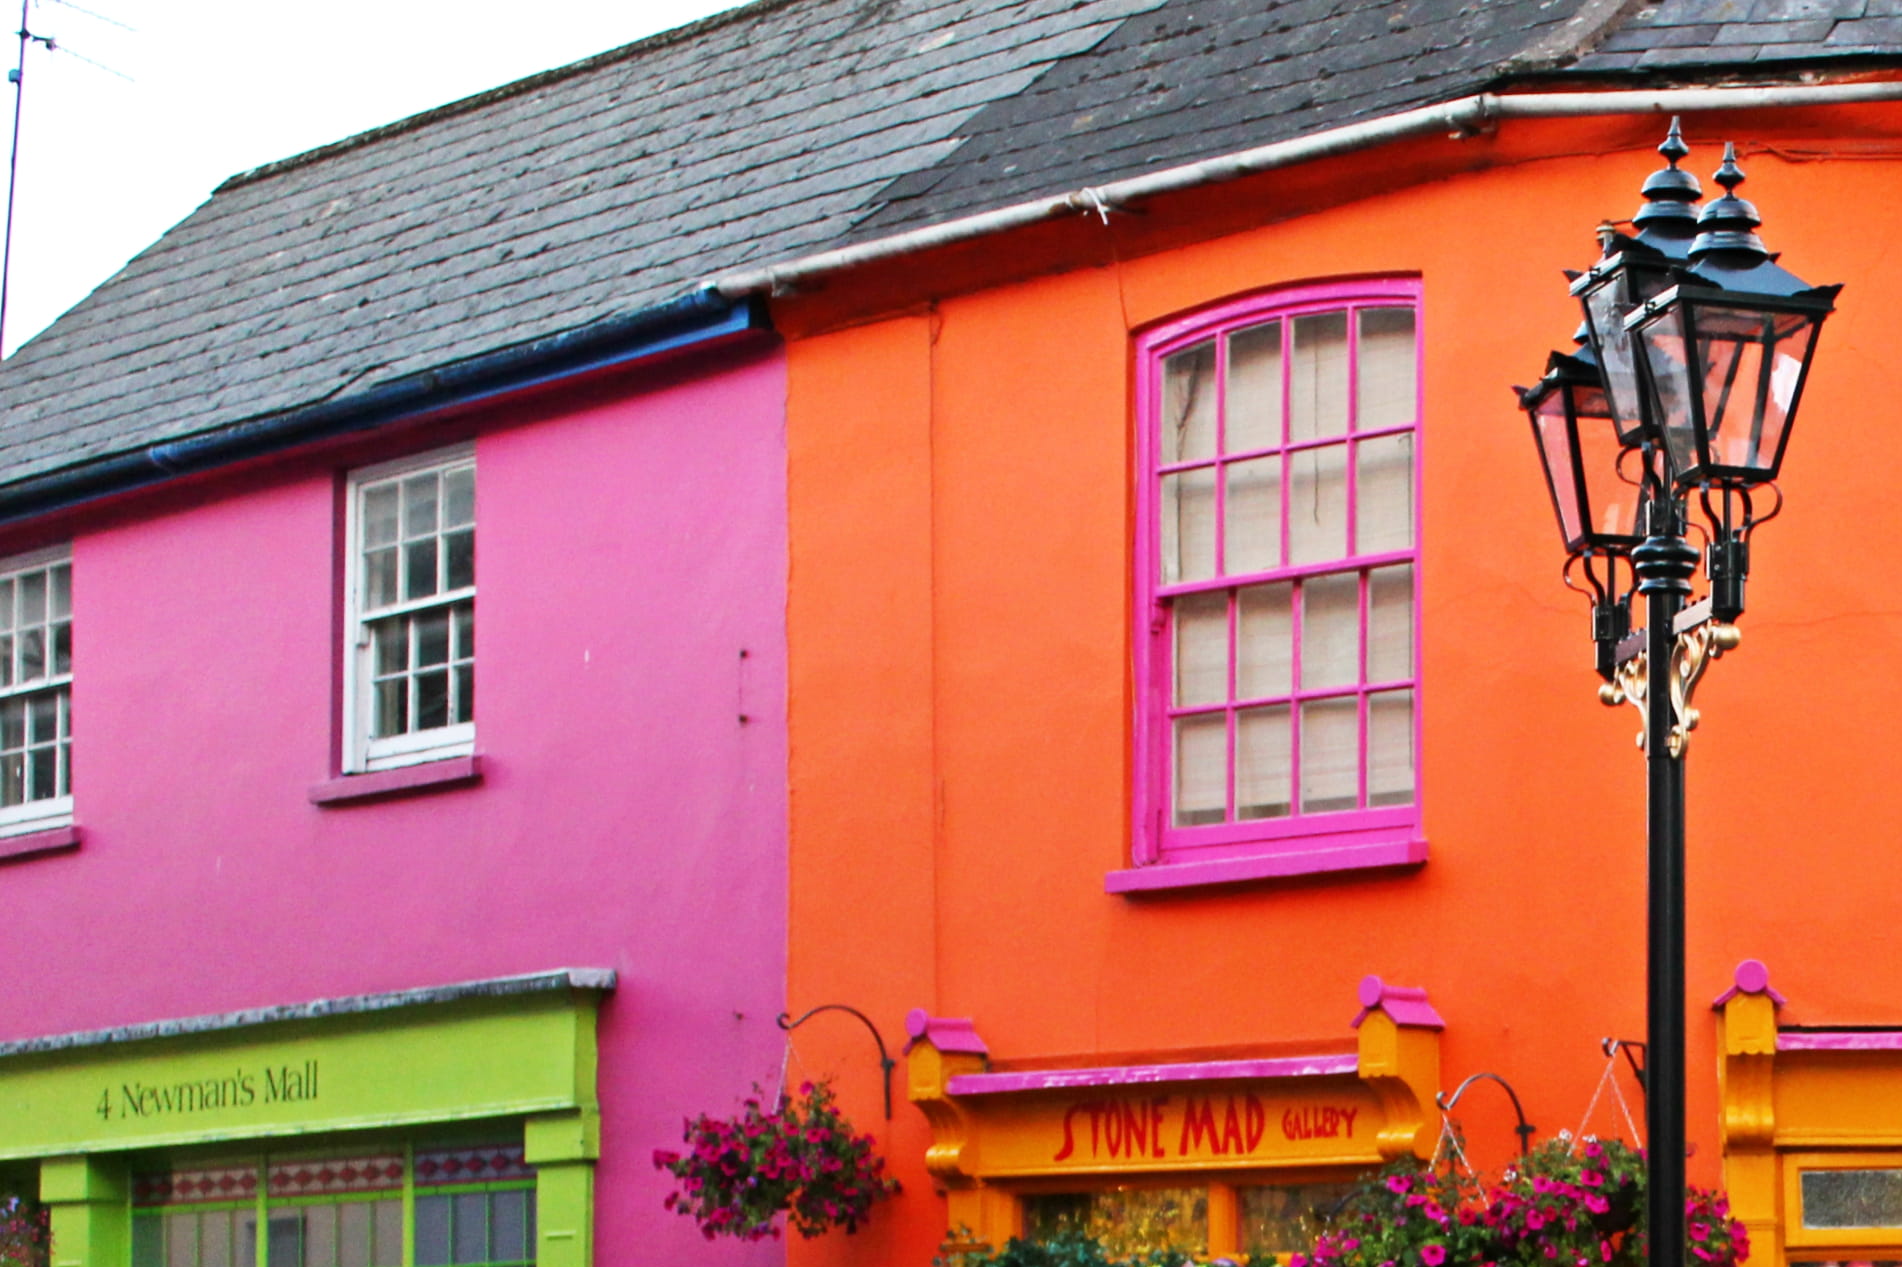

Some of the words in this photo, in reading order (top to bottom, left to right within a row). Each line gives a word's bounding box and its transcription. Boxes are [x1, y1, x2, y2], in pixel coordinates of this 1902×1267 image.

[96, 1087, 112, 1120] 4
[121, 1068, 255, 1118] Newman's
[264, 1060, 318, 1104] Mall
[1053, 1096, 1166, 1161] STONE
[1178, 1093, 1266, 1156] MAD
[1281, 1105, 1358, 1141] GALLERY
